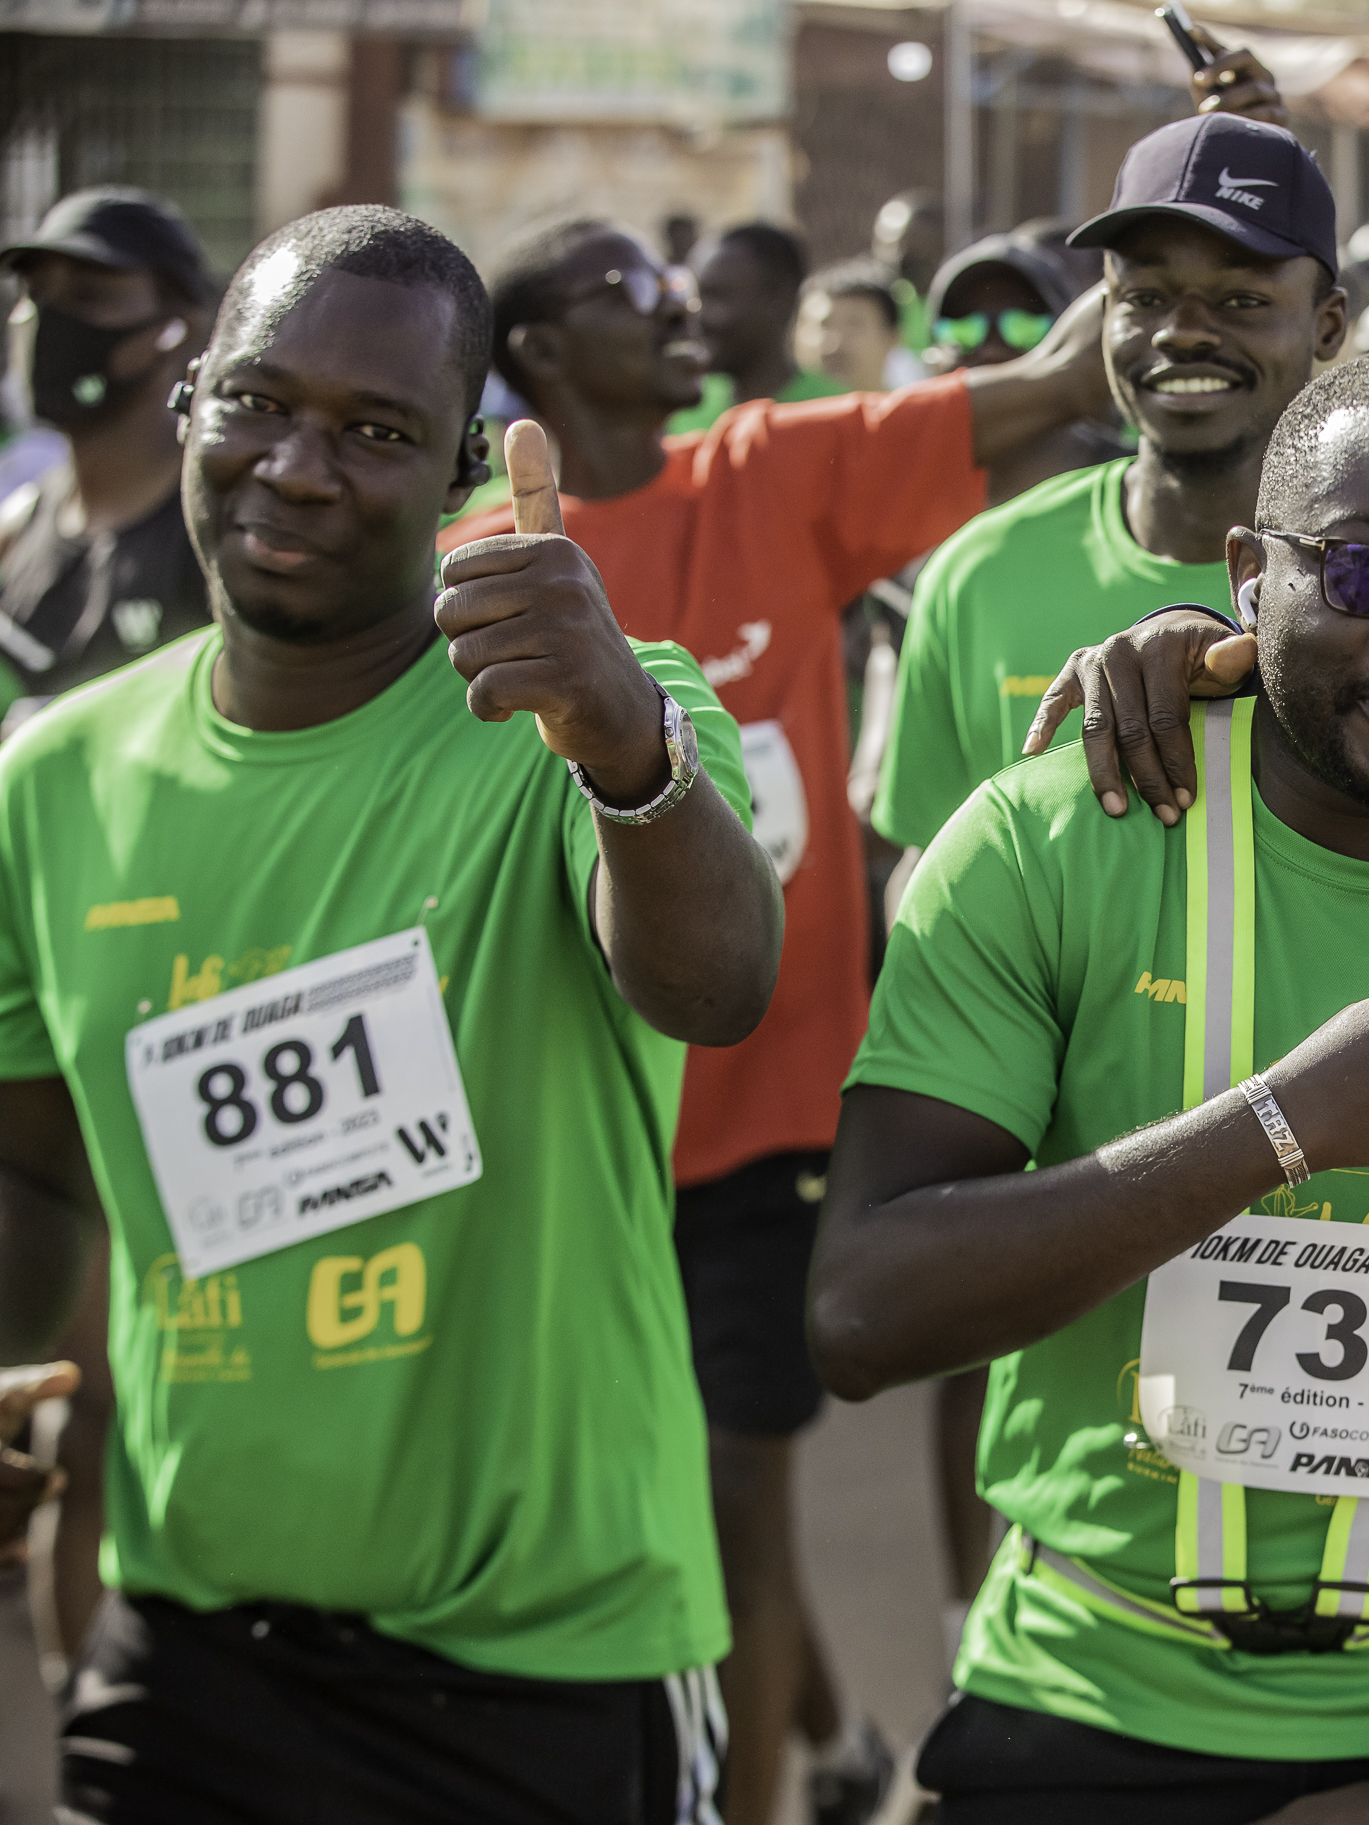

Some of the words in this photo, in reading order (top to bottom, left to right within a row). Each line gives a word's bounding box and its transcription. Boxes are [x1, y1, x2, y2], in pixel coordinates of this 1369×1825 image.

[1215, 186, 1265, 210] NIKE
[197, 1012, 382, 1148] 881
[1190, 1235, 1263, 1262] 10KM
[1256, 1240, 1296, 1267] DE
[306, 1242, 427, 1350] GA
[1281, 1387, 1351, 1409] édition
